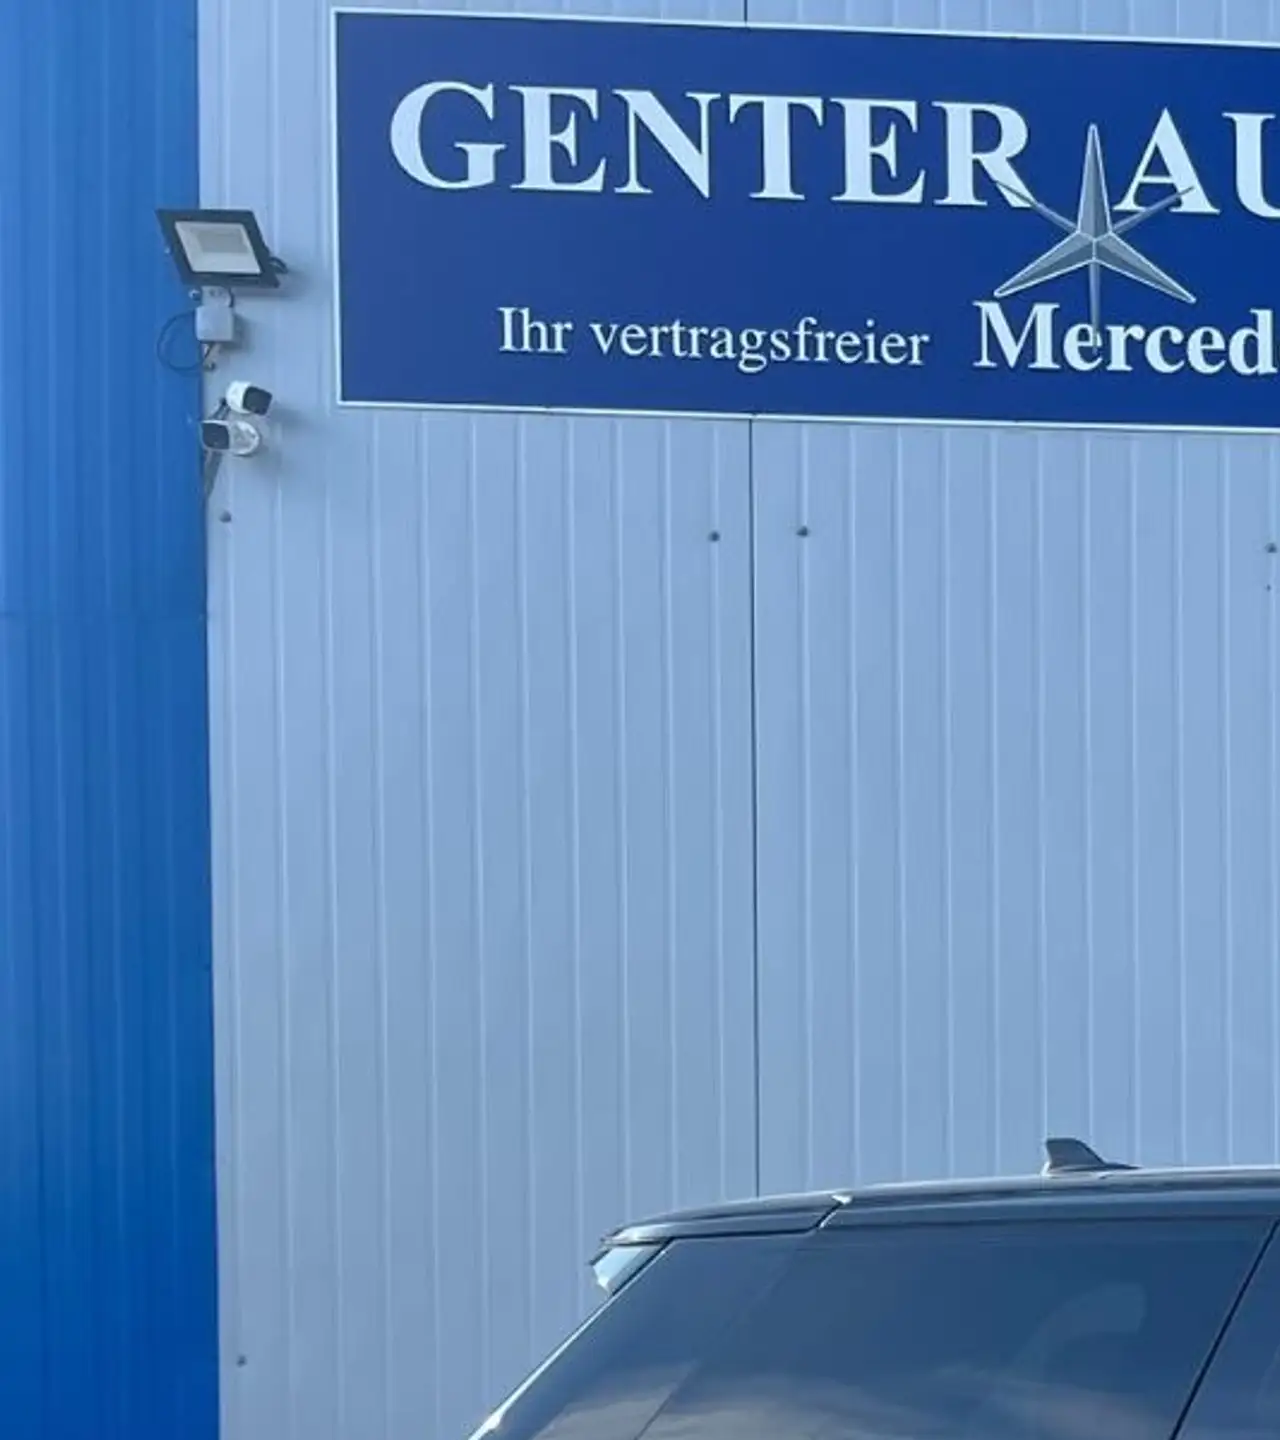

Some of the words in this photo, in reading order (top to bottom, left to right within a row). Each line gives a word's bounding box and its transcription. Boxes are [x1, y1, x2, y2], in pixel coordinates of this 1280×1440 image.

[391, 80, 1031, 208] GENTER
[497, 306, 572, 354] Ihr
[589, 316, 929, 373] vertragsfreier
